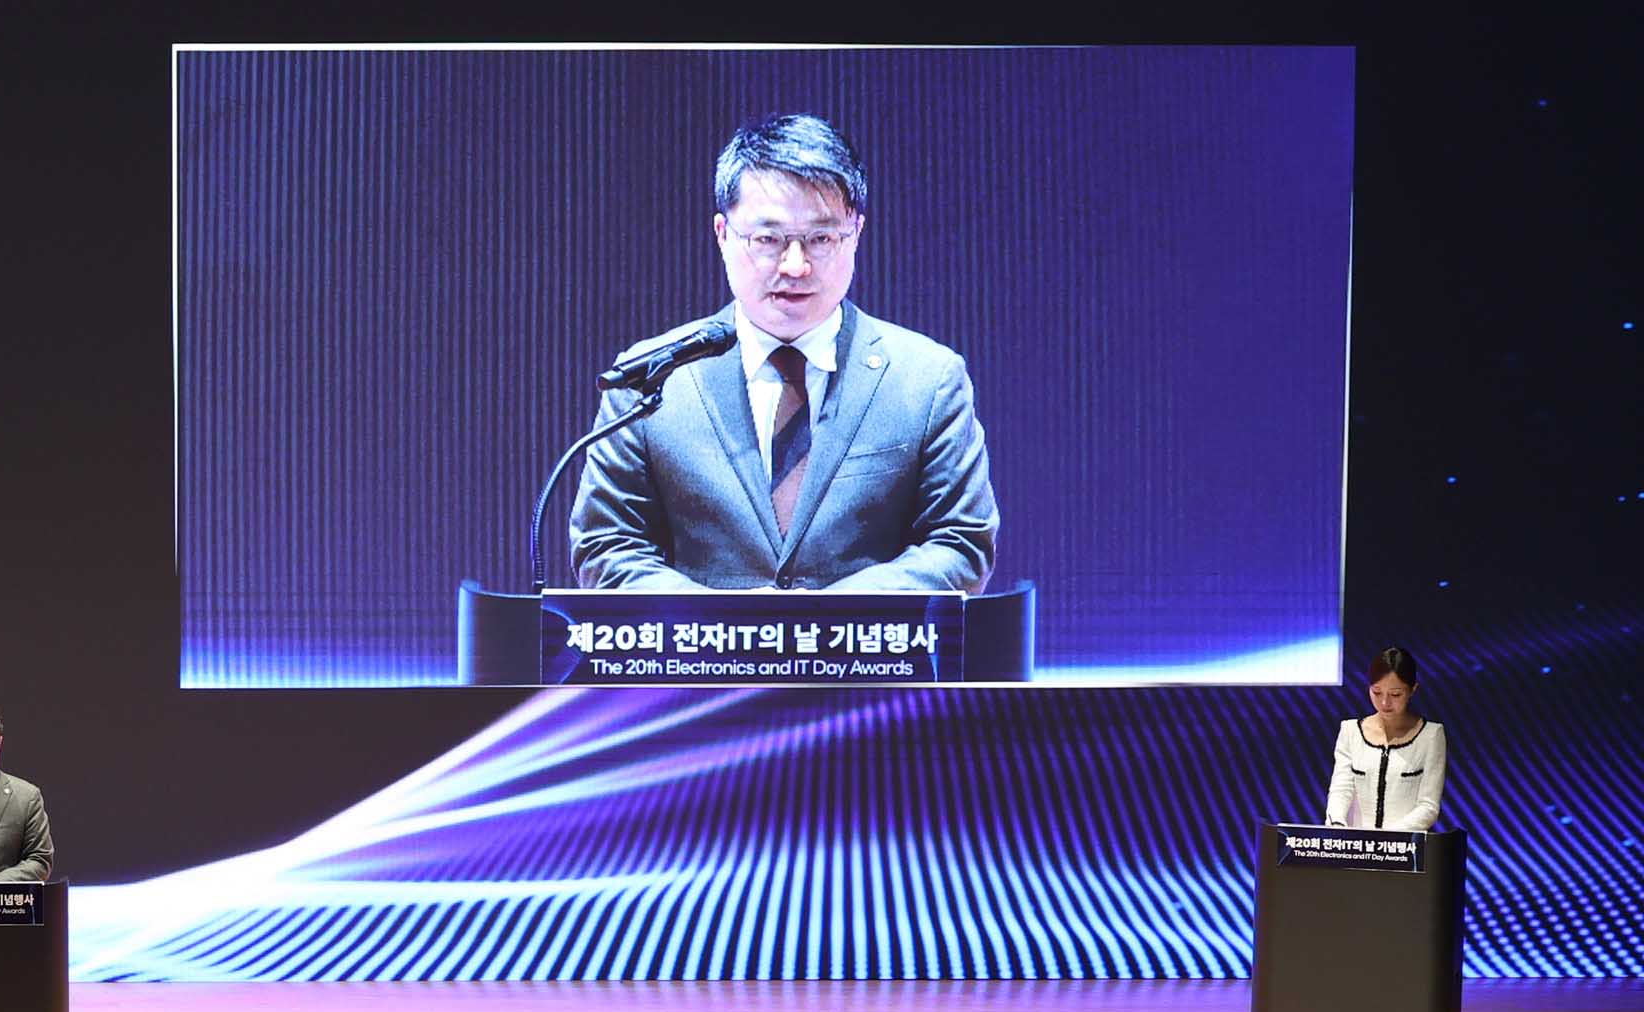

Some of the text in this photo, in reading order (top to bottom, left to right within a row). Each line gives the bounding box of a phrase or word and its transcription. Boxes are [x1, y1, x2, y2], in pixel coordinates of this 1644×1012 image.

[566, 622, 939, 654] 제20회 전자IT의 날 기념행사
[590, 659, 914, 678] The 20th Electronics and IT Day Awards
[1285, 836, 1417, 854] 제20회 전자IT의 날 기념행사
[1320, 851, 1352, 859] Electronics
[1371, 854, 1385, 862] Day
[1385, 854, 1408, 862] Awards
